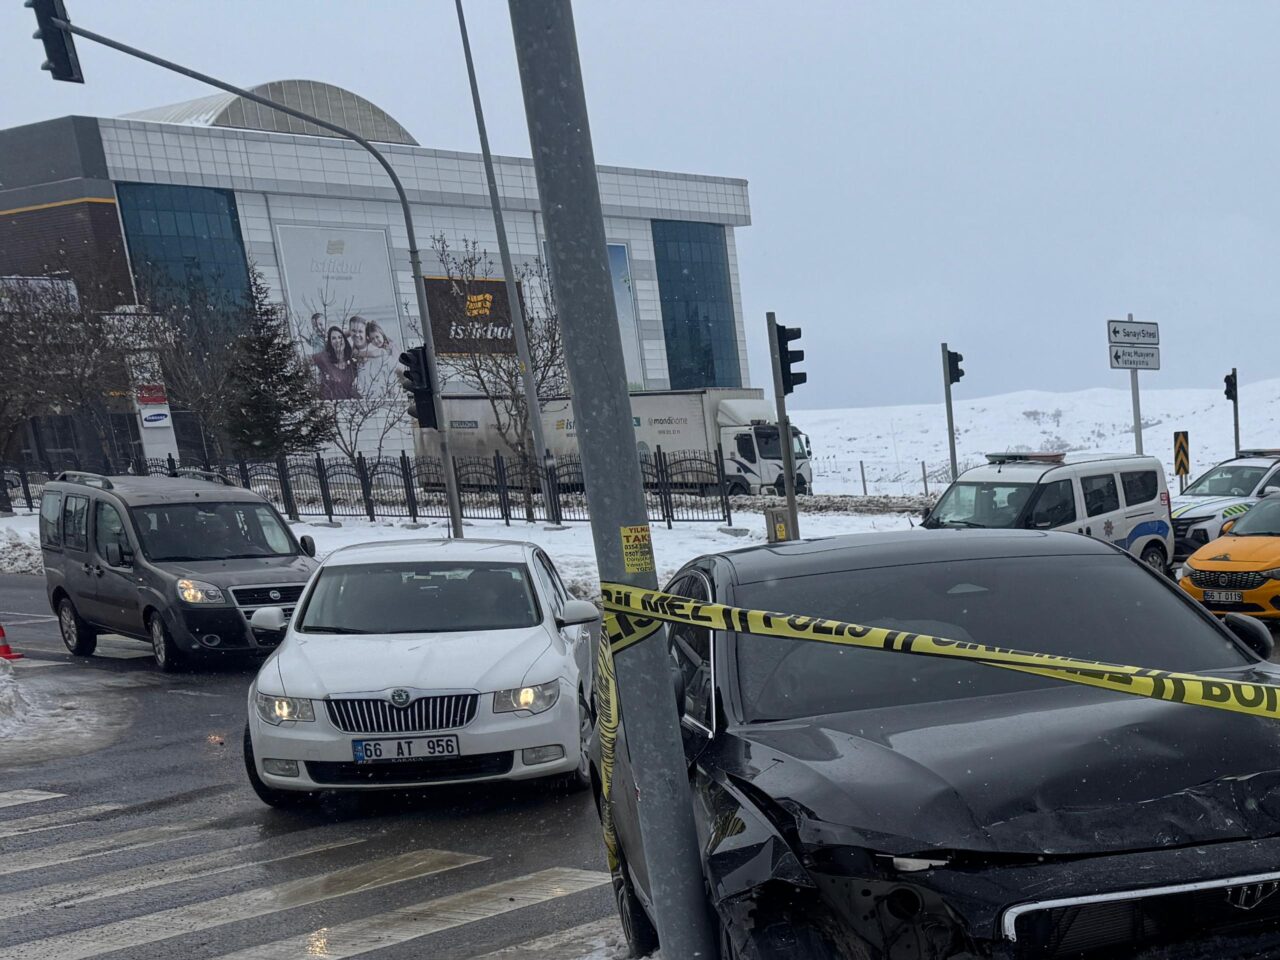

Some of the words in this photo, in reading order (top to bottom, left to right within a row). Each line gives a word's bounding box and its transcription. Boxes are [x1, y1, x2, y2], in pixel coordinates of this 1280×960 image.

[364, 743, 382, 758] 66
[397, 741, 414, 756] AT
[427, 739, 454, 755] 956
